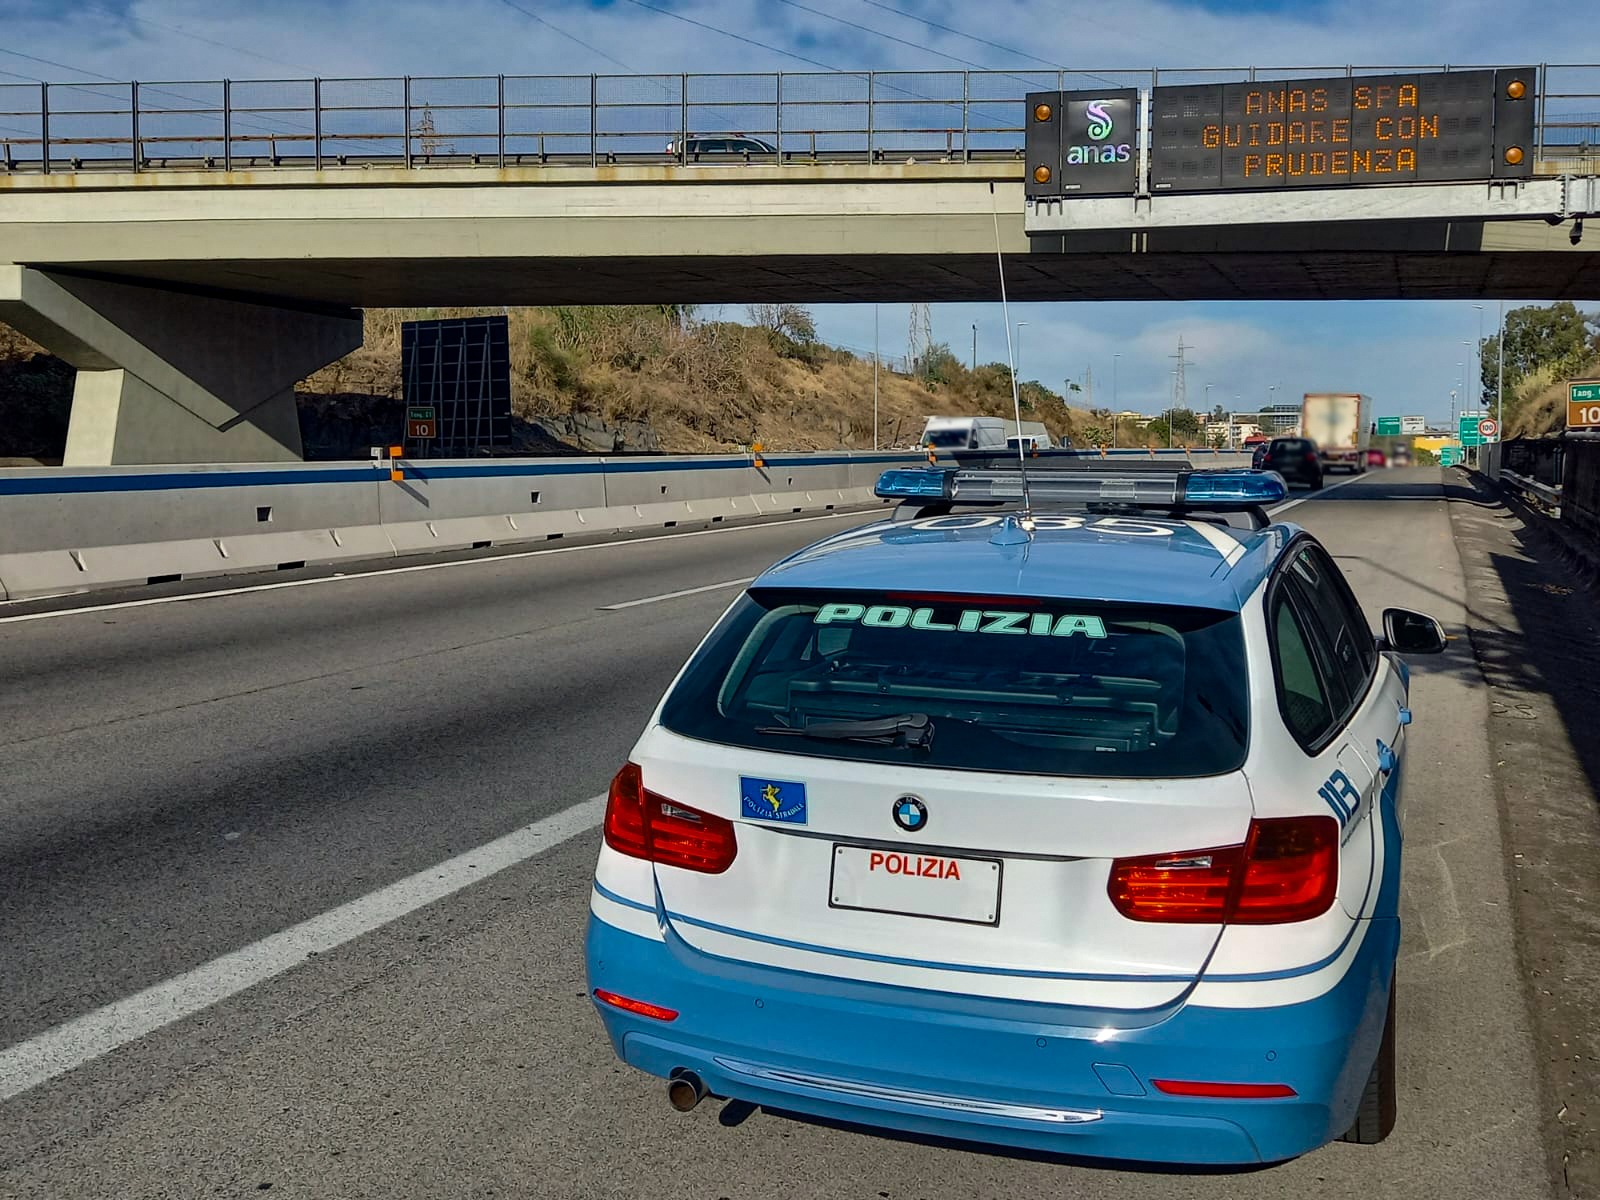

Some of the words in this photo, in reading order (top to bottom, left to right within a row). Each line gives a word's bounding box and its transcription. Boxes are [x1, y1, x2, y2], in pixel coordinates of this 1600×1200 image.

[1245, 88, 1328, 115] ANAS
[1354, 84, 1417, 110] SPA
[1202, 119, 1349, 148] GUIDARE
[1375, 114, 1439, 141] CON
[1067, 143, 1131, 165] anas
[1244, 148, 1416, 177] PRUDENZA
[1573, 388, 1595, 399] Tang.
[1482, 423, 1494, 431] 100
[1580, 406, 1600, 424] 10
[416, 424, 428, 435] 10
[813, 603, 1107, 638] POLIZIA
[743, 796, 773, 818] POLIZIA
[1317, 769, 1361, 830] 113
[869, 852, 961, 881] POLIZIA
